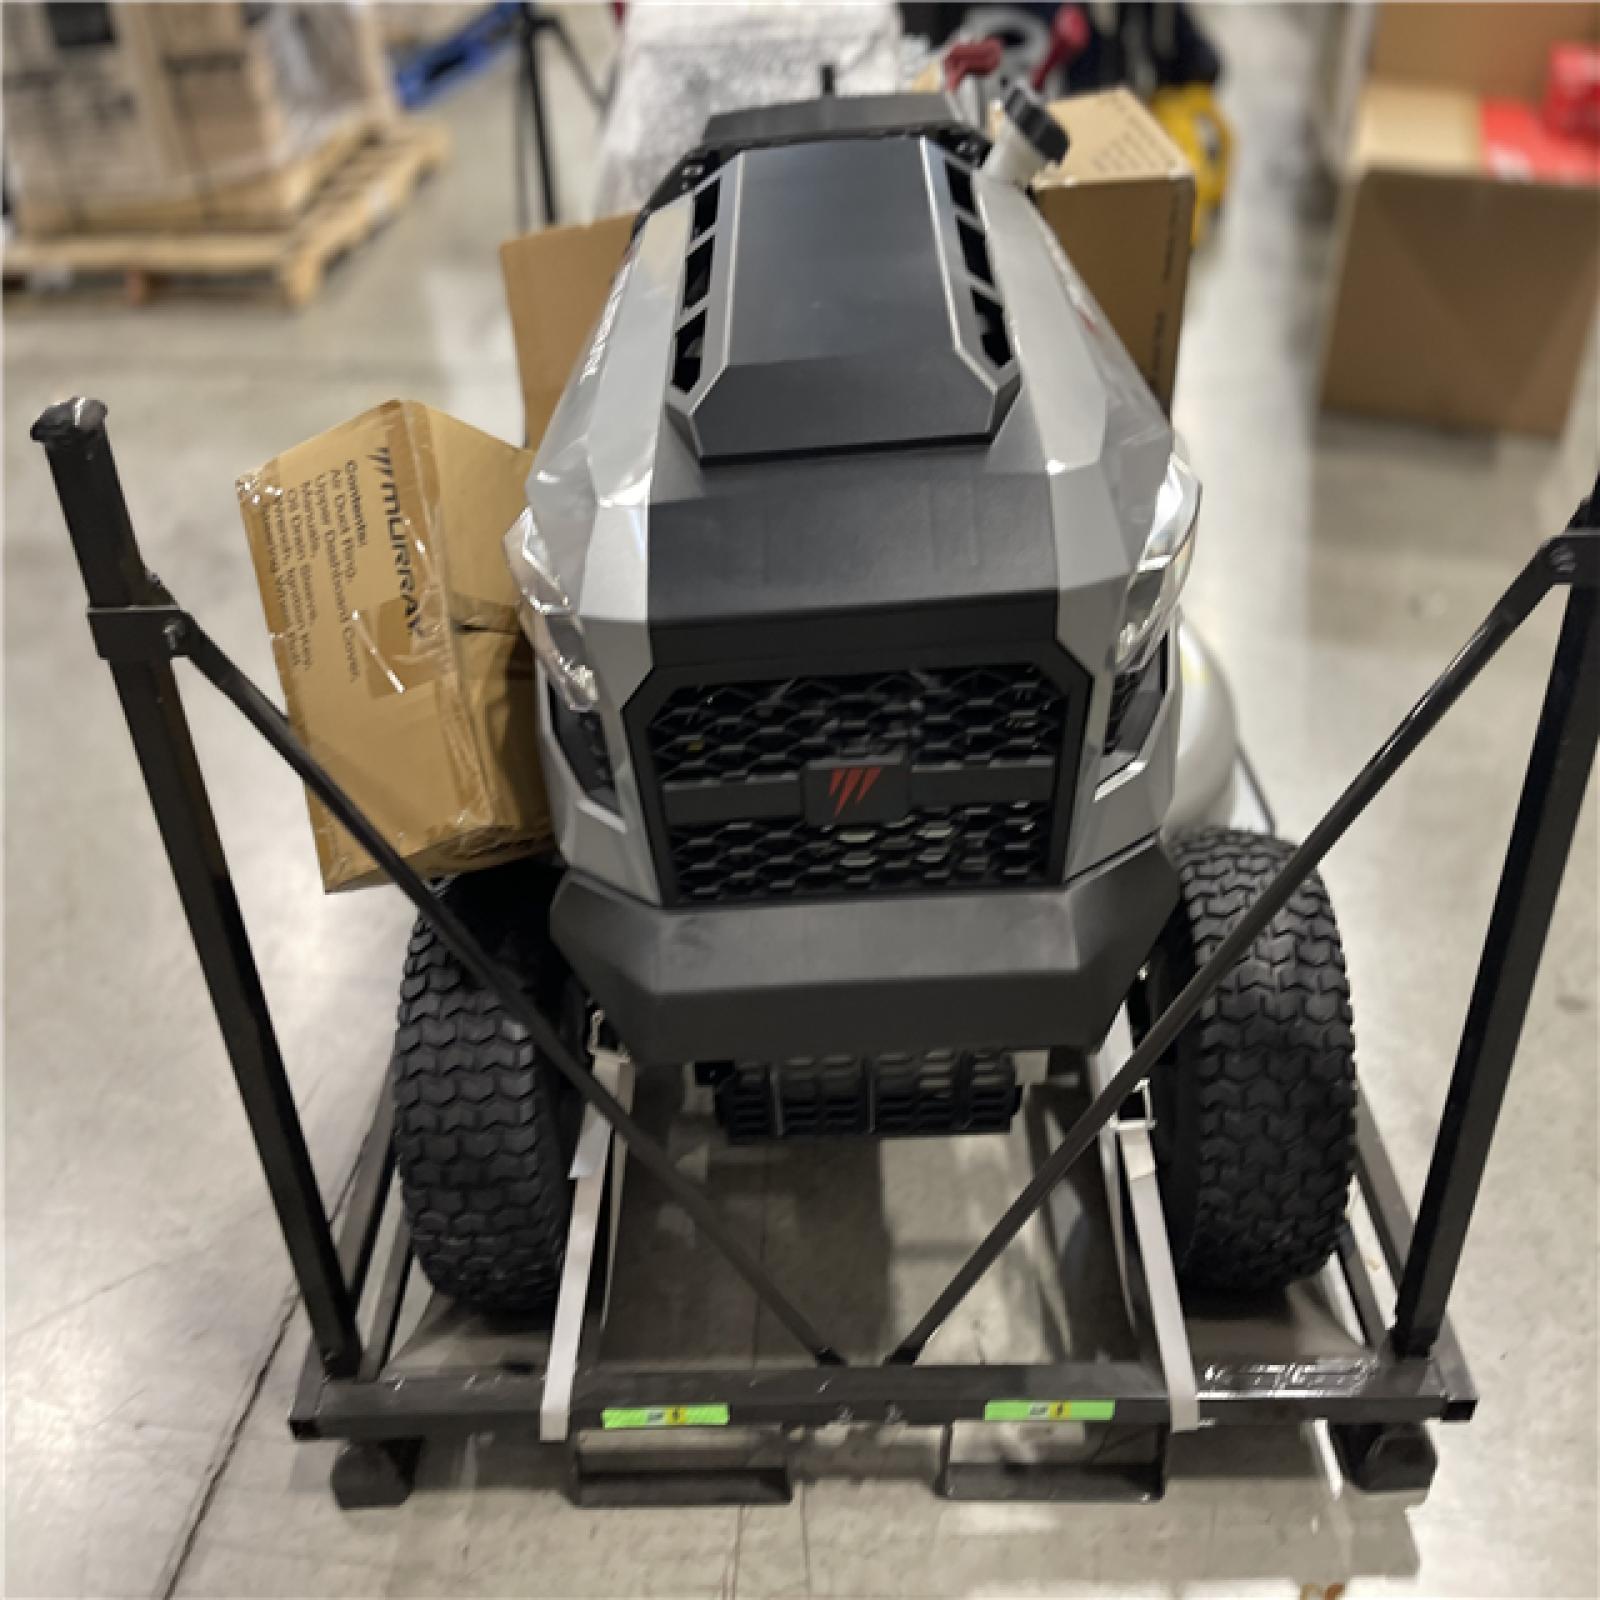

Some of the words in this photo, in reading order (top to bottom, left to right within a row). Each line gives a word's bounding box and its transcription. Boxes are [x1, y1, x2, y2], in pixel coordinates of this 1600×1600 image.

[311, 473, 329, 526] Upper
[325, 529, 350, 623] Dashboard
[335, 494, 351, 534] Duct
[381, 482, 423, 637] MURRAY
